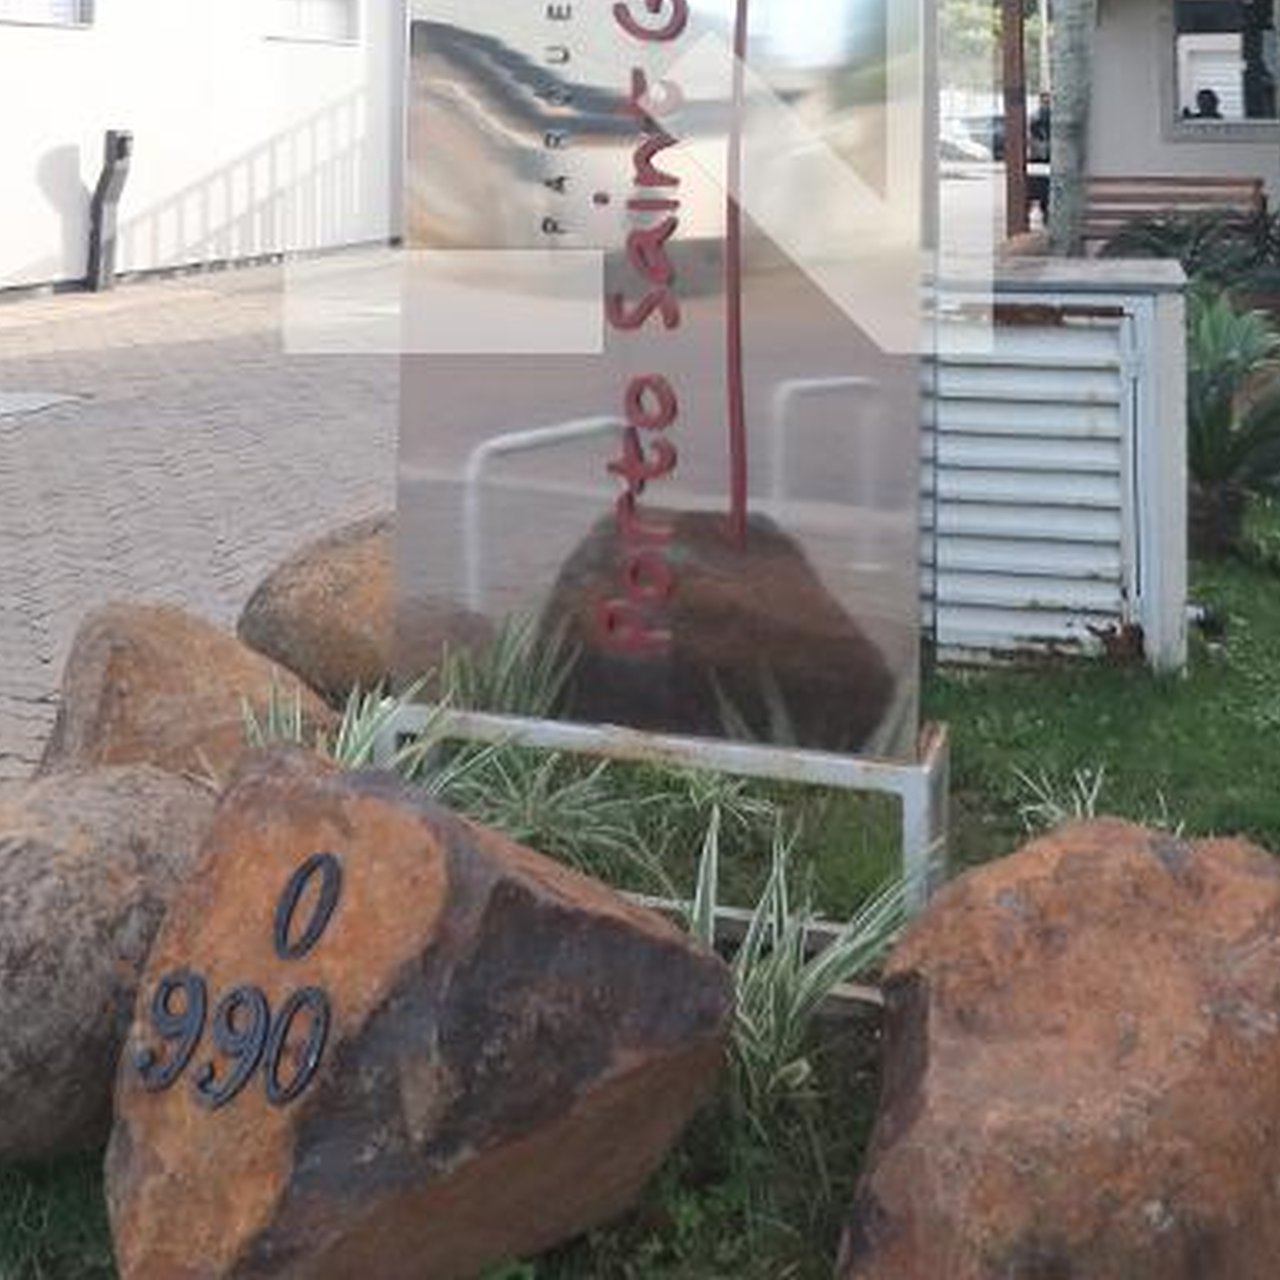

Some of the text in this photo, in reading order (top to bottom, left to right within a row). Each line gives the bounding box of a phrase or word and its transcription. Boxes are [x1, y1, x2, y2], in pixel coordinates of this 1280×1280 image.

[592, 65, 684, 331] Saint
[596, 372, 679, 656] Porto
[132, 973, 330, 1108] 990
